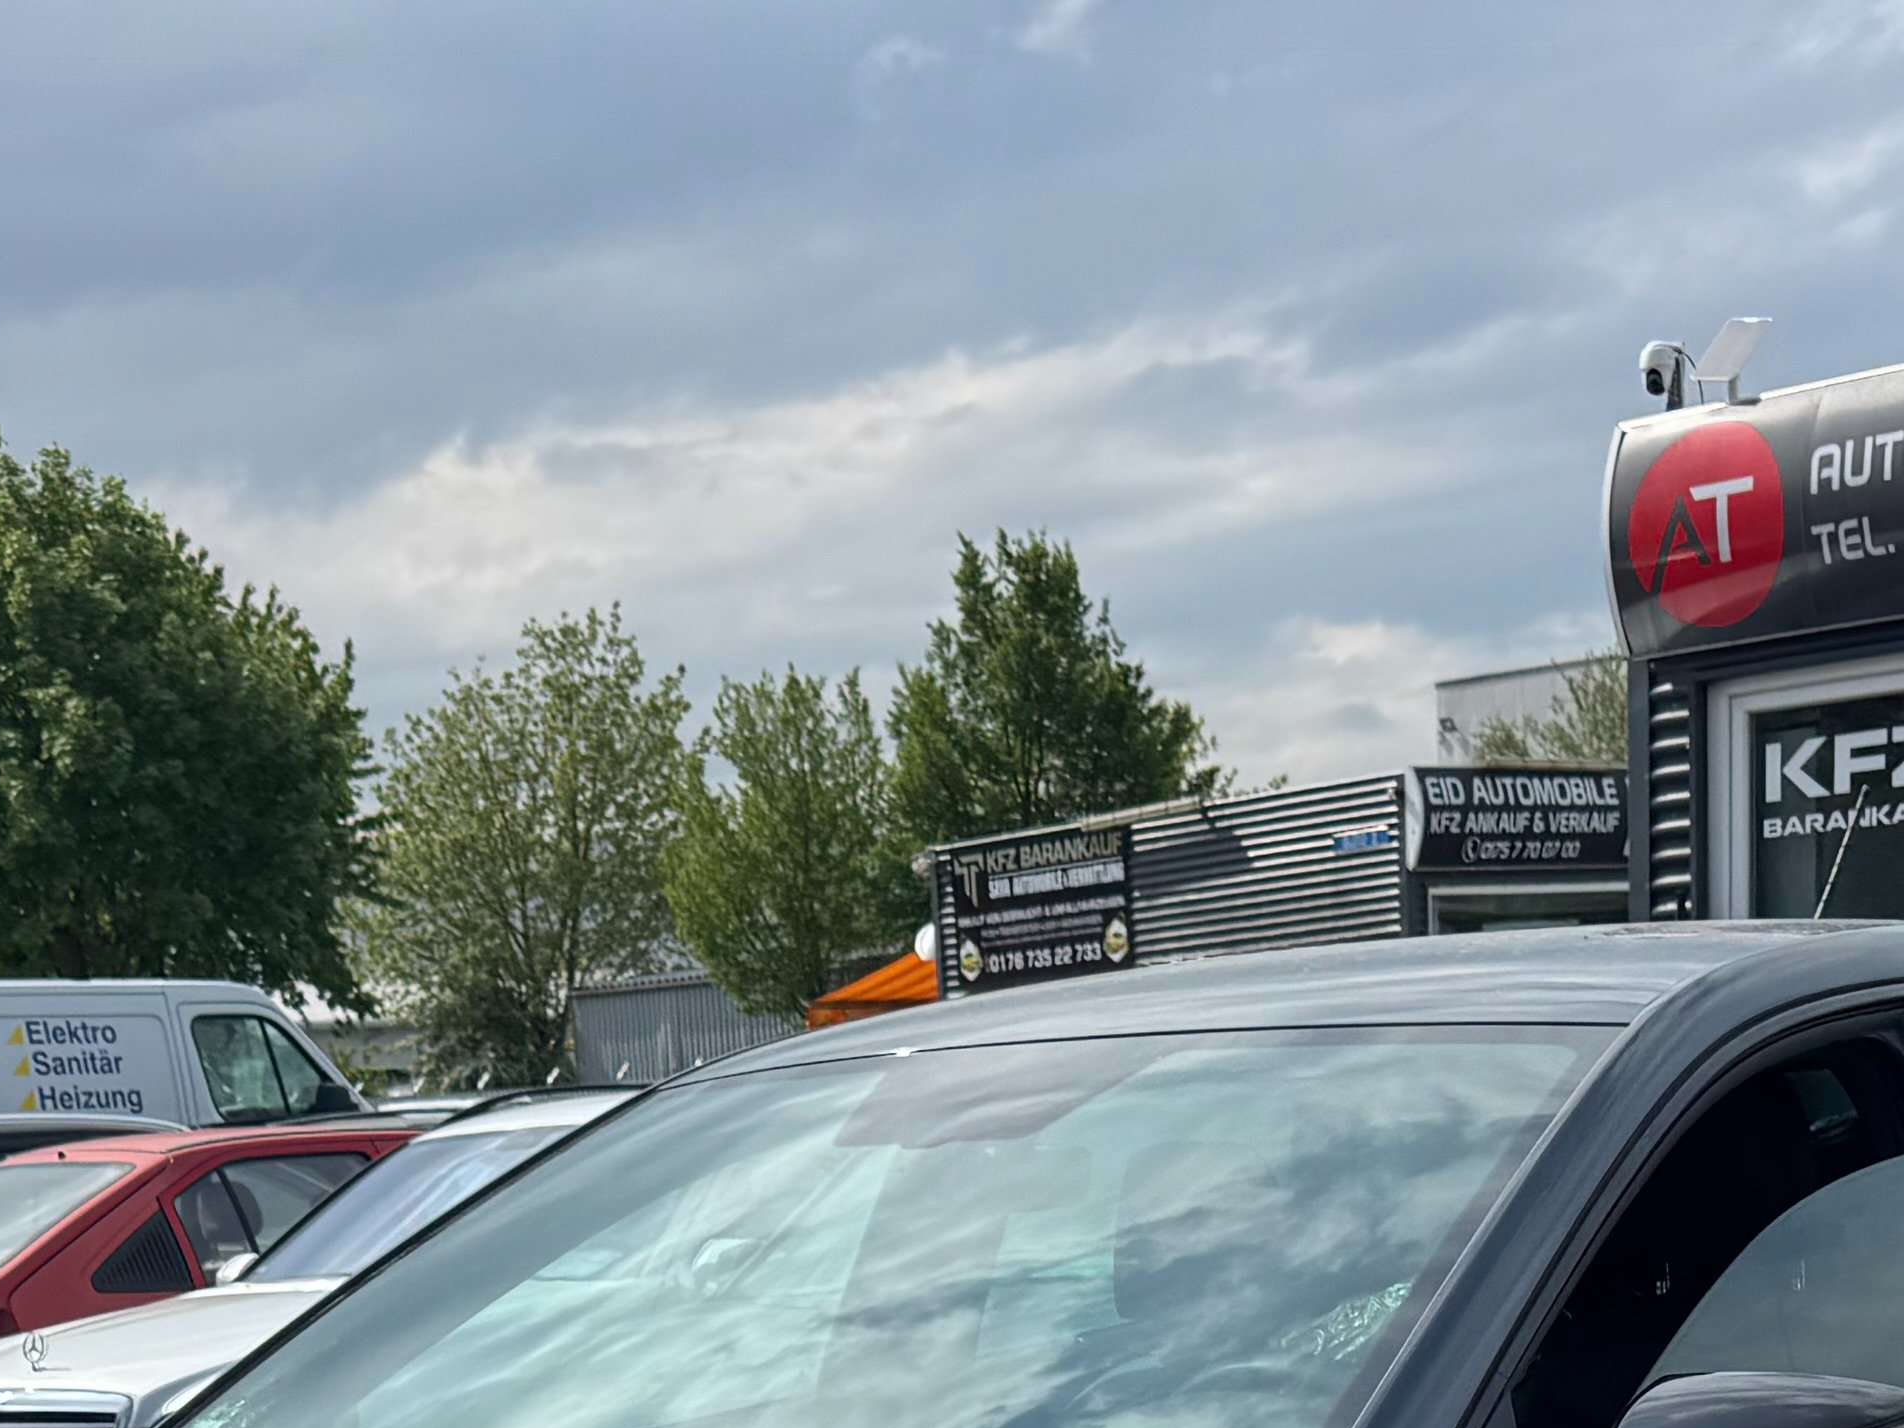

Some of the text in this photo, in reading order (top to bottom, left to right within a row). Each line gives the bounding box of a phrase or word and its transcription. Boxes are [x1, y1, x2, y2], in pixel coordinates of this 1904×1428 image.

[1650, 475, 1755, 594] AT
[1811, 523, 1895, 566] TEL.
[1424, 776, 1620, 806] EID AUTOMOBILE
[1430, 812, 1461, 834] KFZ
[1465, 812, 1531, 834] ANKAUF
[1549, 811, 1621, 834] VERKAUF
[987, 831, 1123, 873] KFZ BARANKAUF
[1074, 943, 1102, 962] 733
[26, 1020, 117, 1045] Elektro
[32, 1050, 124, 1076] Sanitär
[38, 1086, 144, 1113] Heizung
